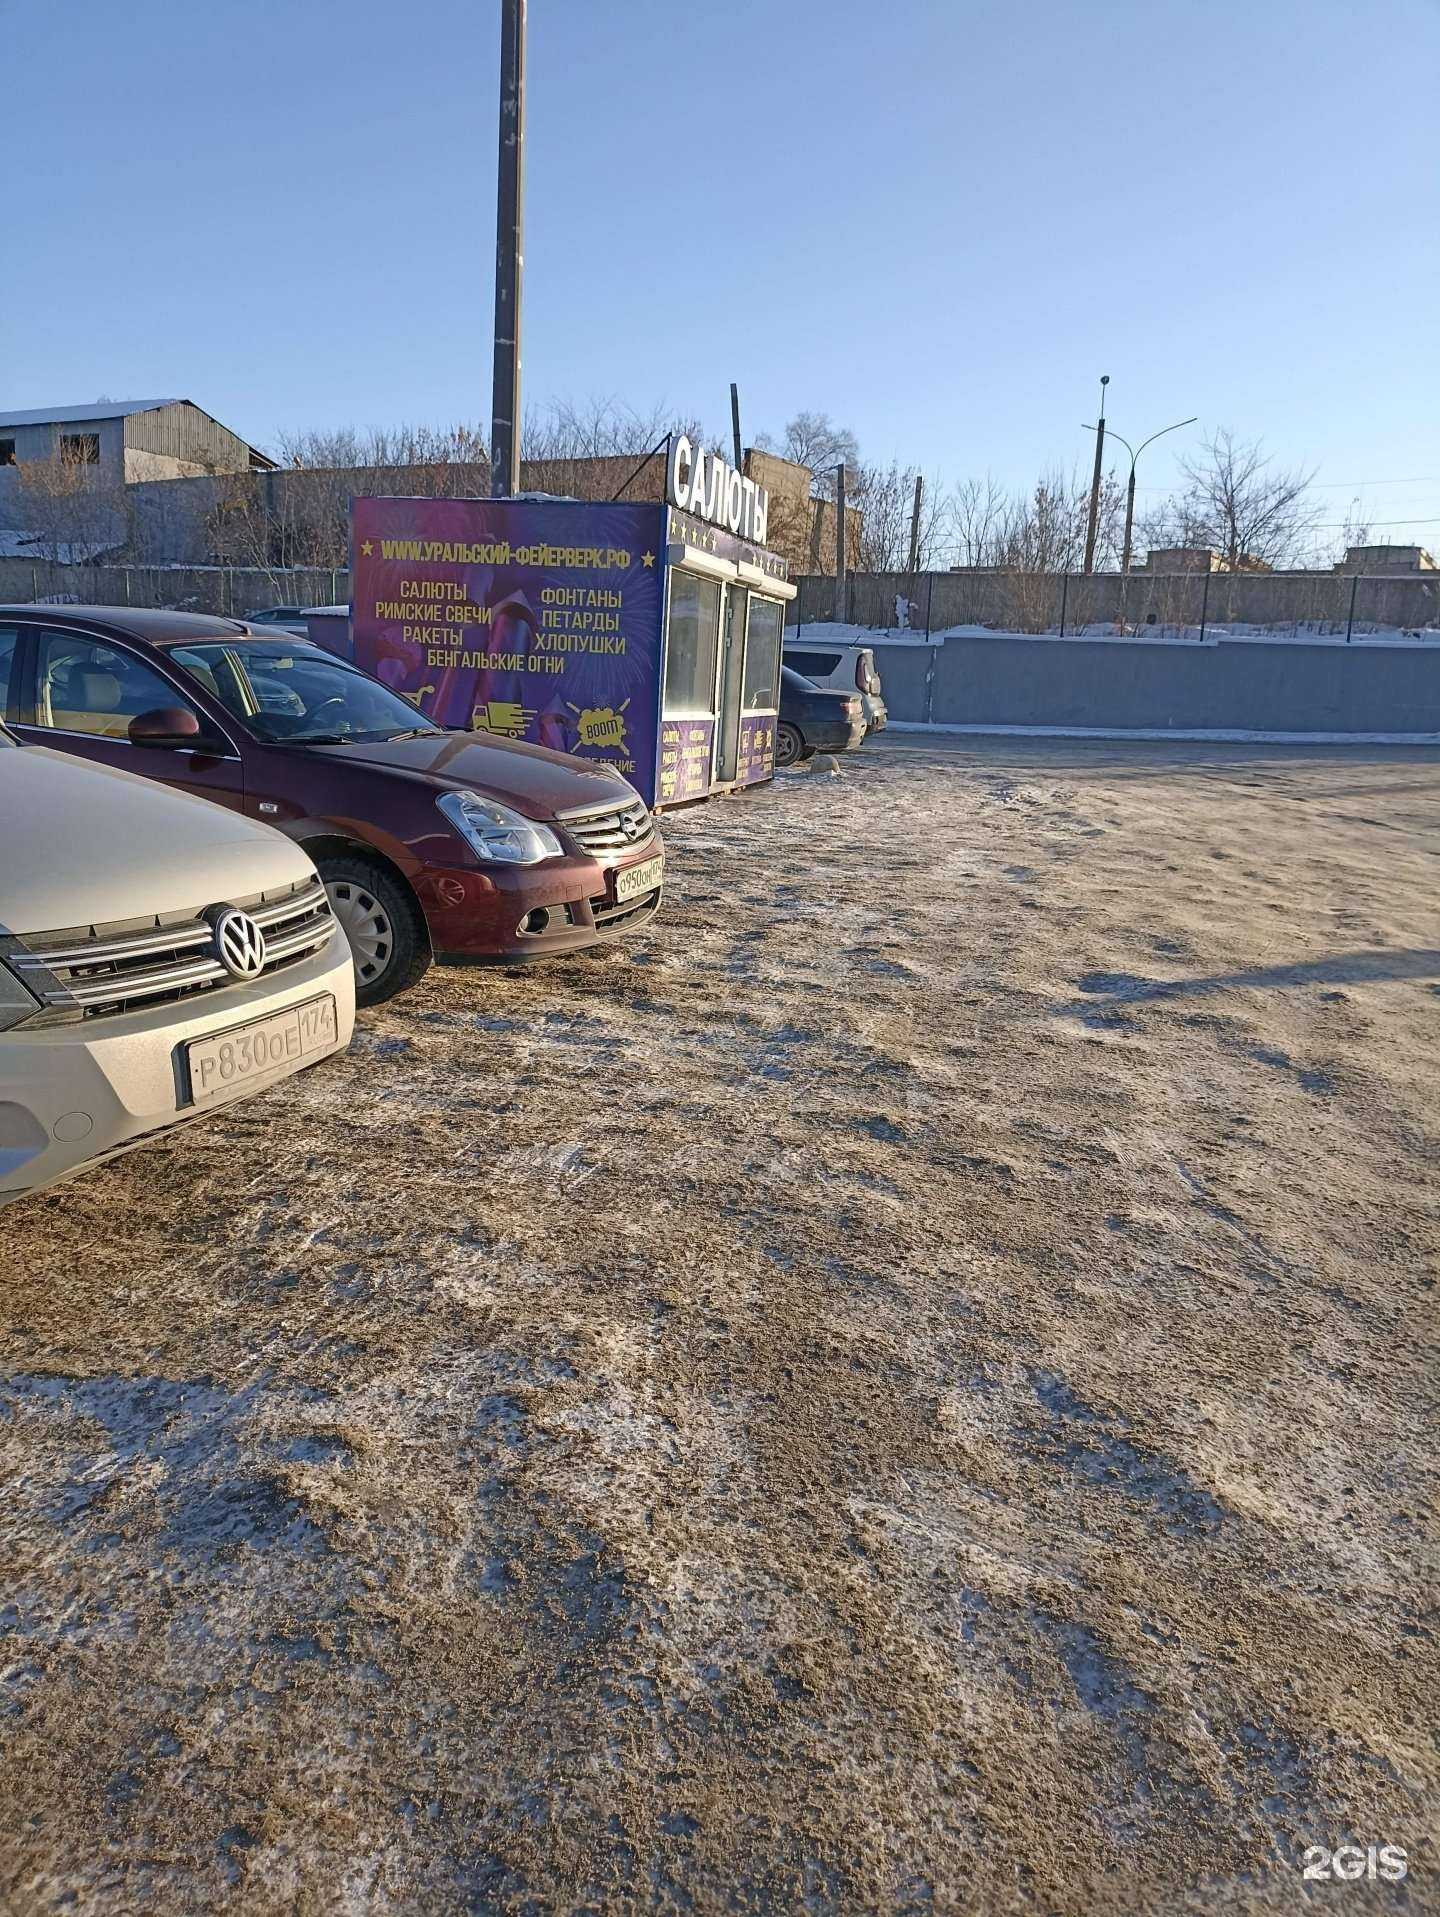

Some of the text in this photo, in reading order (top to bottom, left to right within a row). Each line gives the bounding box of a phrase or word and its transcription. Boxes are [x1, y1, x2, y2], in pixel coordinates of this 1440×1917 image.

[673, 435, 768, 546] САЛЮТЫ
[381, 540, 631, 569] WWW.УРАЛЬСКИЙ-ФЕЙЕРВЕРК.РФ
[400, 580, 467, 601] САЛЮТЫ
[540, 587, 622, 609] ФОНТАНЫ
[375, 602, 492, 625] РИМСКИЕ СВЕЧИ
[542, 609, 620, 632] ПЕТАРДЫ
[403, 626, 463, 646] РАКЕТЫ
[534, 633, 626, 655] ХЛОПУШКИ
[427, 650, 564, 674] БЕНГАЛЬСКИЕ ОГНИ
[587, 719, 618, 739] BOOM
